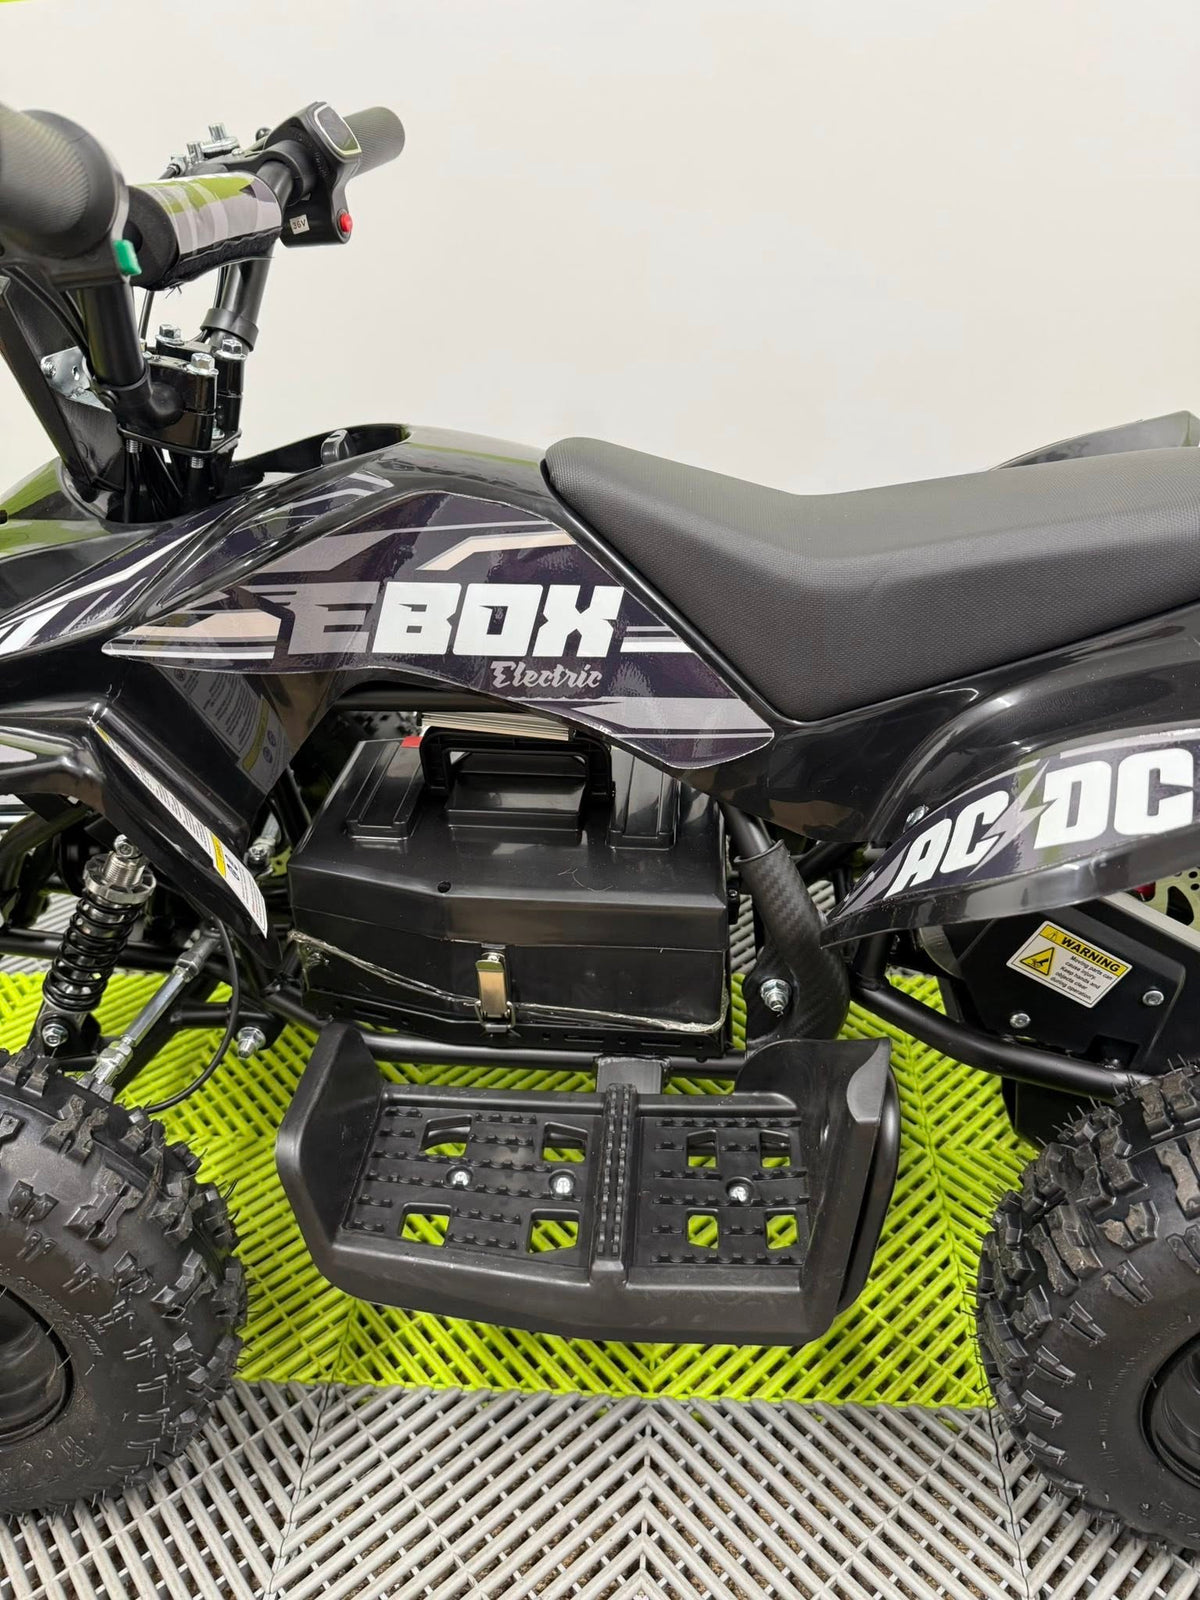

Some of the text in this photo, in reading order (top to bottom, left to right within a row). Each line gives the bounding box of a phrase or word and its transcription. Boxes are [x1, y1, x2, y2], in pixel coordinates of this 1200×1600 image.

[292, 219, 307, 230] 36V
[490, 660, 603, 689] Electric
[1061, 936, 1121, 972] WARNING
[1065, 961, 1081, 971] cause
[1070, 955, 1089, 969] Moving
[1088, 966, 1103, 976] parts
[1050, 976, 1067, 988] during
[1055, 971, 1088, 990] objects clear
[1060, 966, 1101, 990] Keep hands and
